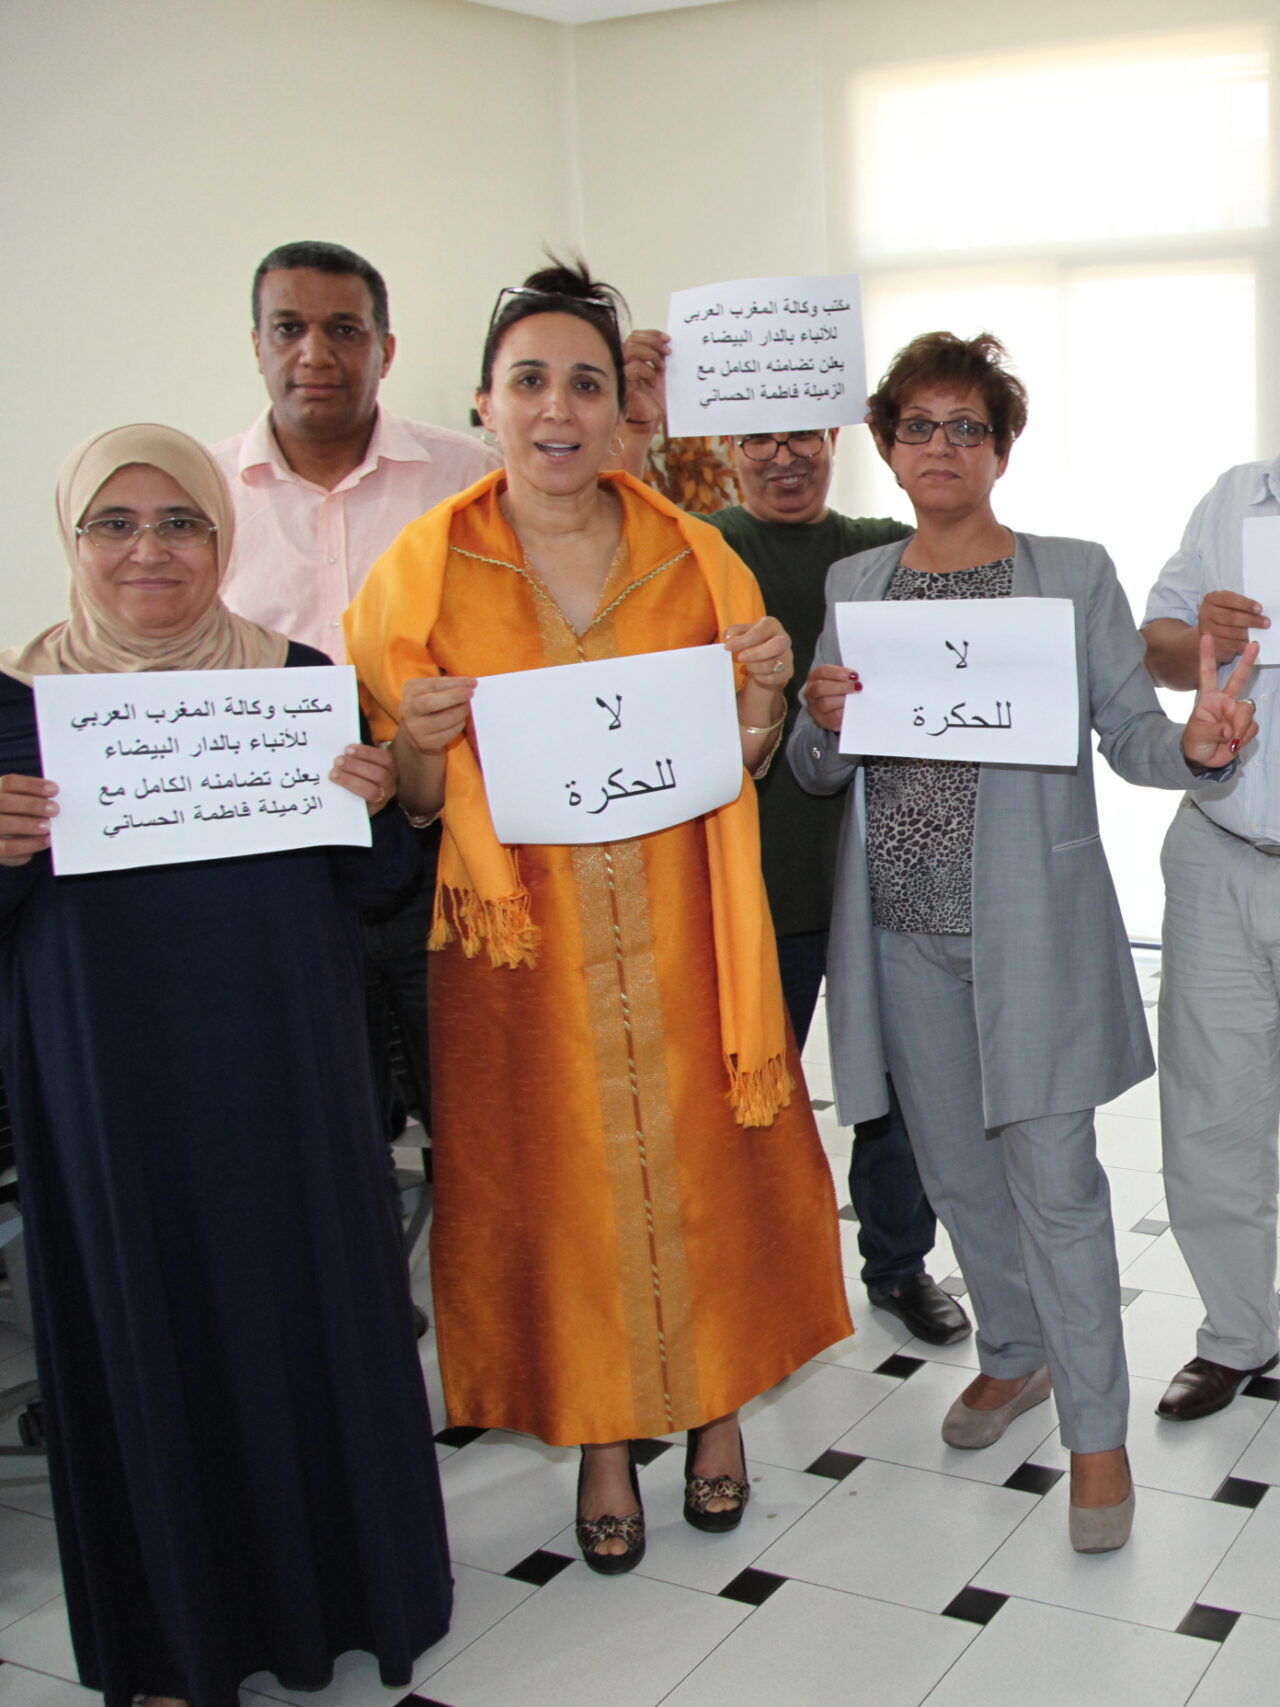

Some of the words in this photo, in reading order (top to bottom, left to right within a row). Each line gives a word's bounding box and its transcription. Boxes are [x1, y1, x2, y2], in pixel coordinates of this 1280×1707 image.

[684, 304, 723, 325] العربي
[730, 301, 777, 319] المغرب
[783, 298, 818, 317] وكالة
[822, 299, 851, 316] مكتب
[702, 330, 752, 347] البيضاء
[759, 329, 795, 346] بالدار
[697, 365, 716, 381] مع
[721, 360, 760, 377] الكامل
[766, 358, 814, 372] تضامنه
[819, 356, 844, 374] يعلن
[699, 387, 754, 409] الحساني
[760, 384, 799, 399] فاطمة
[804, 382, 844, 400] الزميلة
[945, 640, 969, 669] لا
[71, 703, 136, 731] العربي
[146, 700, 215, 723] المغرب
[224, 697, 275, 720] وكالة
[283, 698, 332, 718] مكتب
[595, 694, 623, 731] لا
[913, 700, 1012, 736] للحكرة
[105, 736, 179, 760] البيضاء
[189, 734, 241, 757] بالدار
[250, 728, 308, 752] للأنباء
[134, 775, 192, 799] الكامل
[200, 771, 272, 790] تضامنه
[280, 768, 320, 789] يعلن
[565, 758, 677, 814] للحكرة
[99, 786, 126, 806] مع
[258, 796, 323, 817] الزميلة
[193, 801, 251, 821] فاطمة
[103, 810, 185, 838] الحساني
